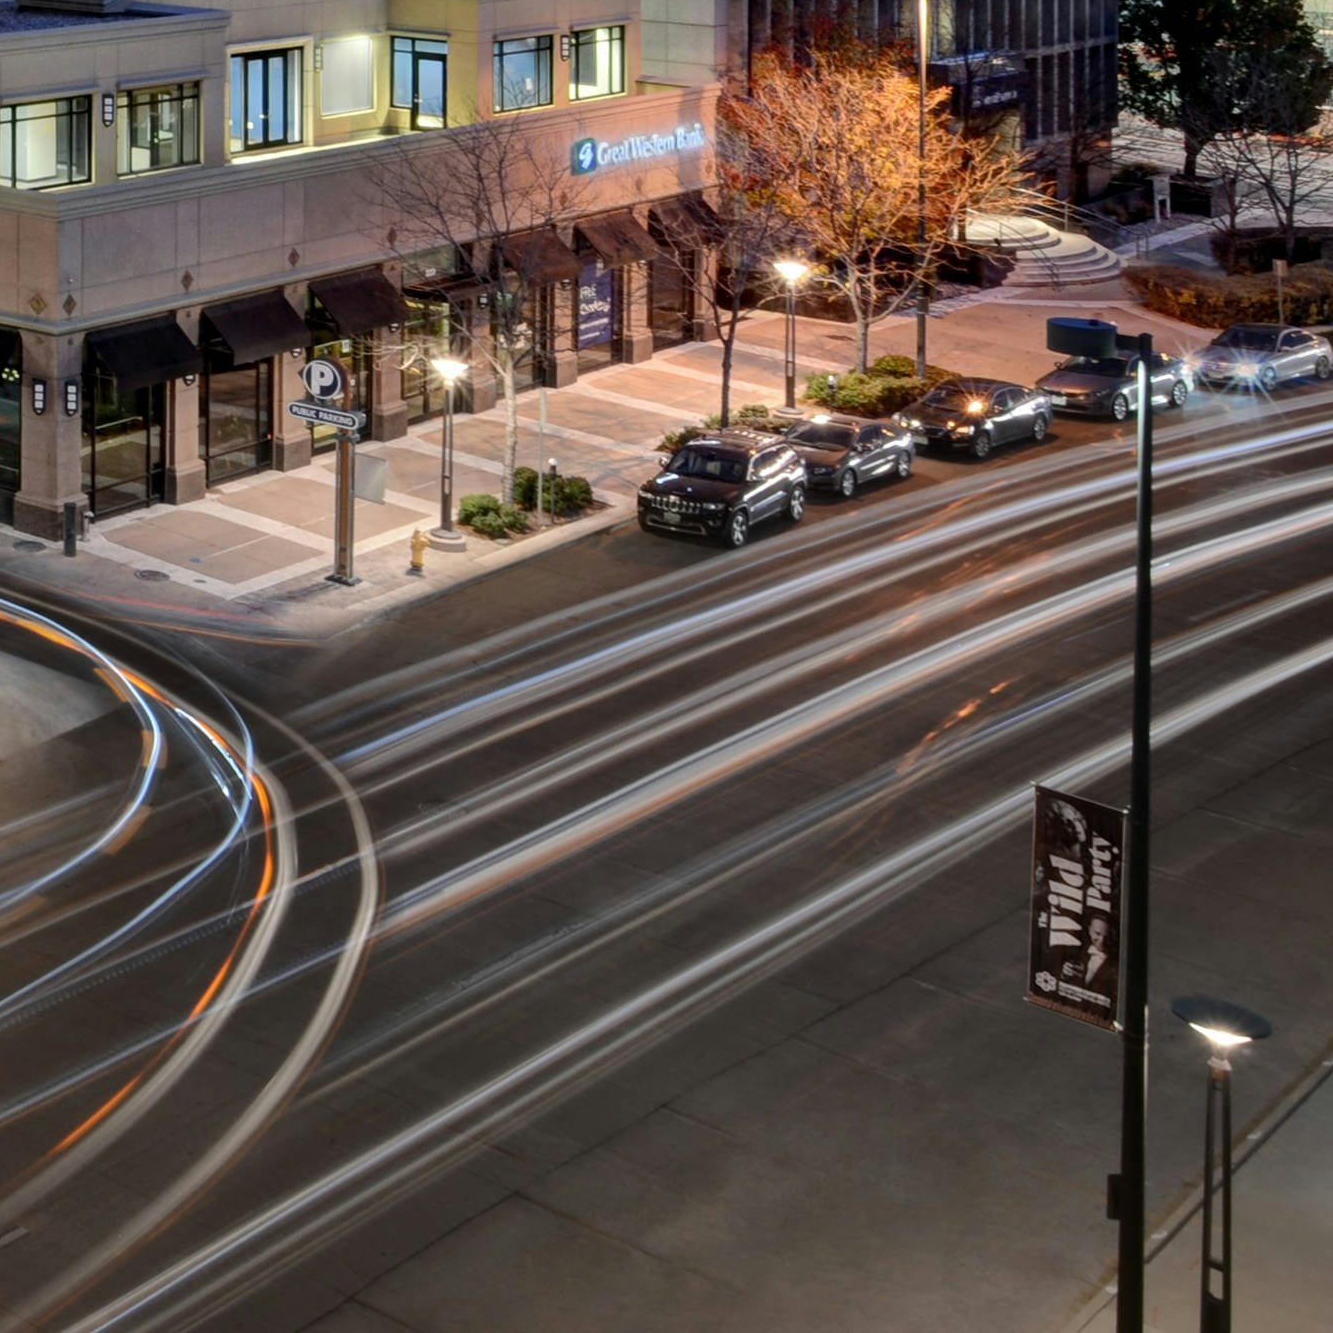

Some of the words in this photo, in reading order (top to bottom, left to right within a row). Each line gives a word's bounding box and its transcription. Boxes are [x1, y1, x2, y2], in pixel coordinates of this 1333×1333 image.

[597, 141, 630, 165] Great
[629, 133, 675, 157] Western
[675, 123, 704, 149] Bank
[311, 365, 333, 394] P
[292, 405, 318, 418] PUBLIC
[318, 411, 353, 426] PARKING
[1086, 830, 1120, 913] Party
[1048, 853, 1084, 947] Wild
